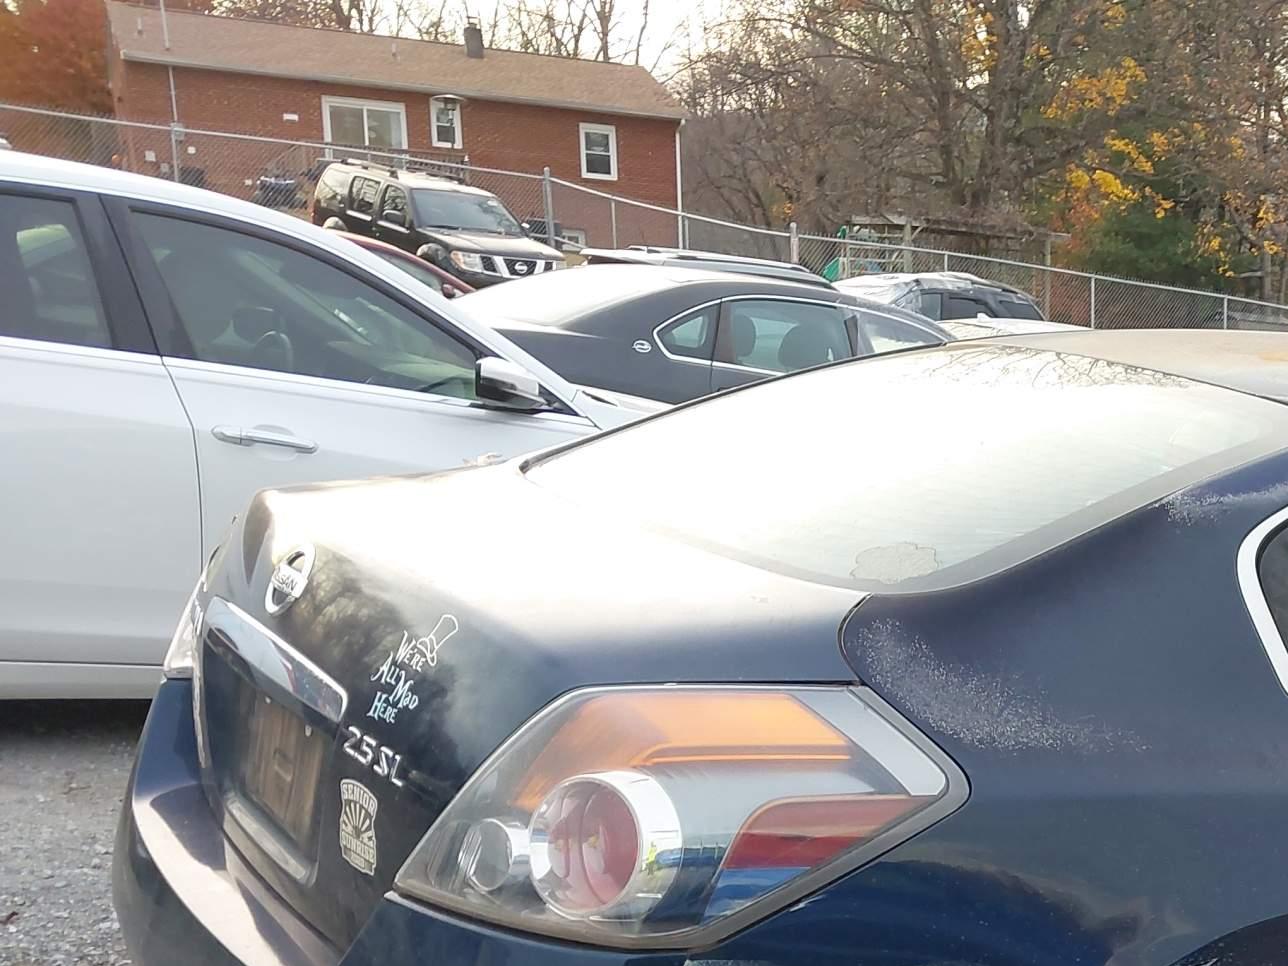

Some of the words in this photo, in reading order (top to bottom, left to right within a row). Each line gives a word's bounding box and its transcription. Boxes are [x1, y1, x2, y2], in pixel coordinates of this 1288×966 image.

[366, 690, 399, 725] HERE
[372, 745, 404, 788] SL
[341, 782, 376, 818] SENIOR
[341, 830, 376, 865] SUNRISE
